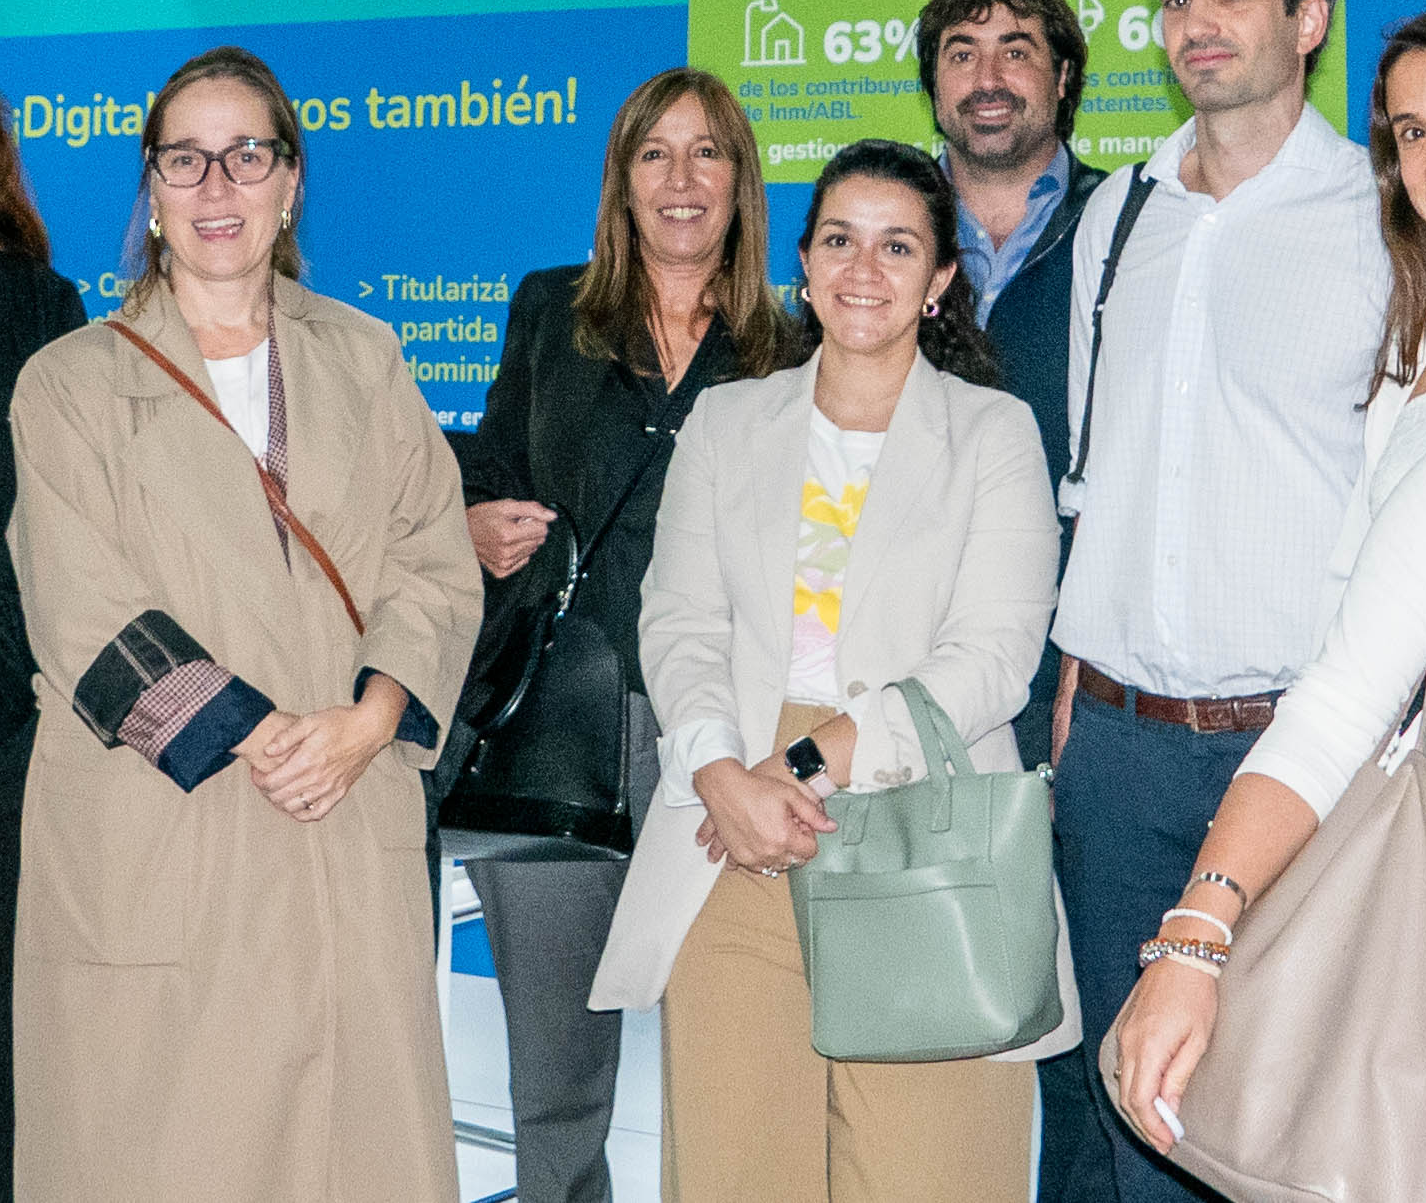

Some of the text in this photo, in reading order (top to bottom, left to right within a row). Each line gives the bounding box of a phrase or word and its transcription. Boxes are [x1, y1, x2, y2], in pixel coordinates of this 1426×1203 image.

[739, 80, 763, 97] de
[769, 78, 799, 96] los
[365, 74, 577, 130] también!
[769, 100, 863, 120] Inm/ABL.
[1081, 94, 1173, 114] atentes.
[381, 273, 510, 302] Titularizá
[401, 315, 498, 347] partida
